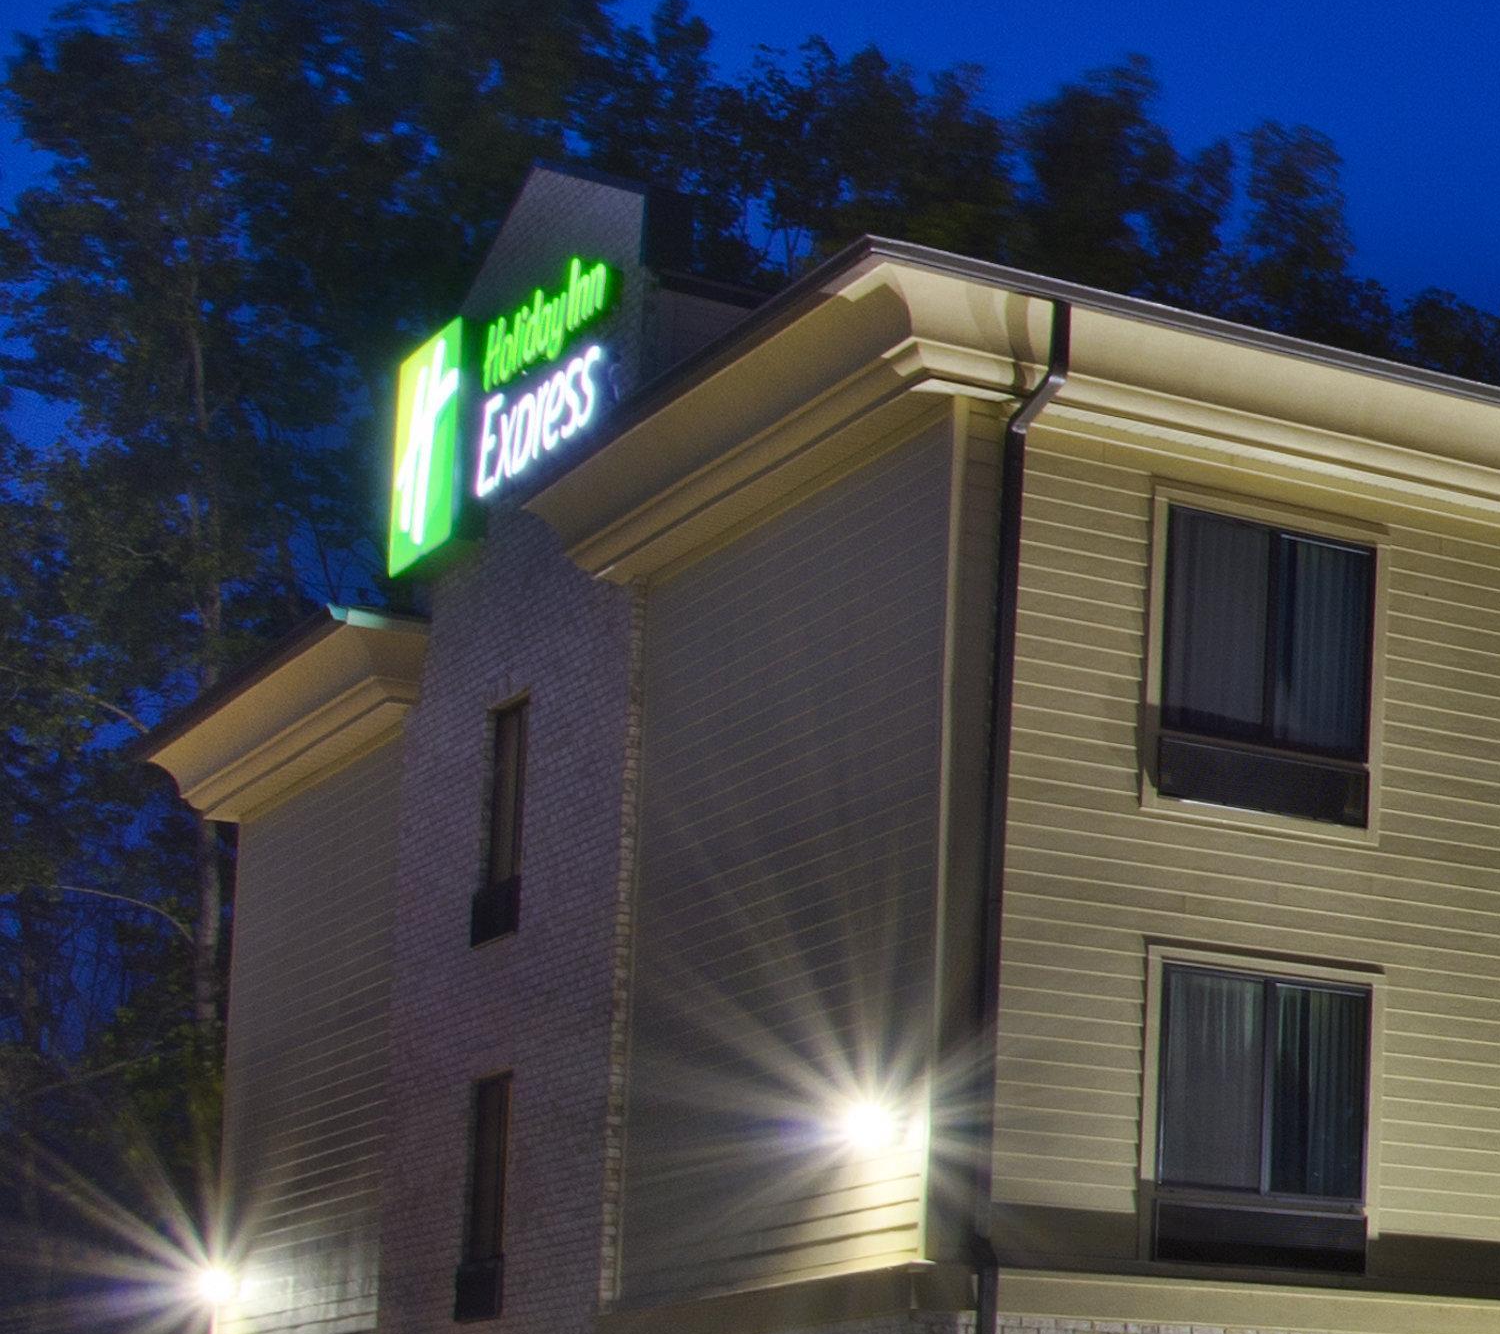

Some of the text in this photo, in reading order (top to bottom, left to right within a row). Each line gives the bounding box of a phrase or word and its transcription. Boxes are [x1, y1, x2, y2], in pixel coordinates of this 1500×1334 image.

[483, 256, 608, 393] Holiday Inn
[475, 344, 603, 498] Express
